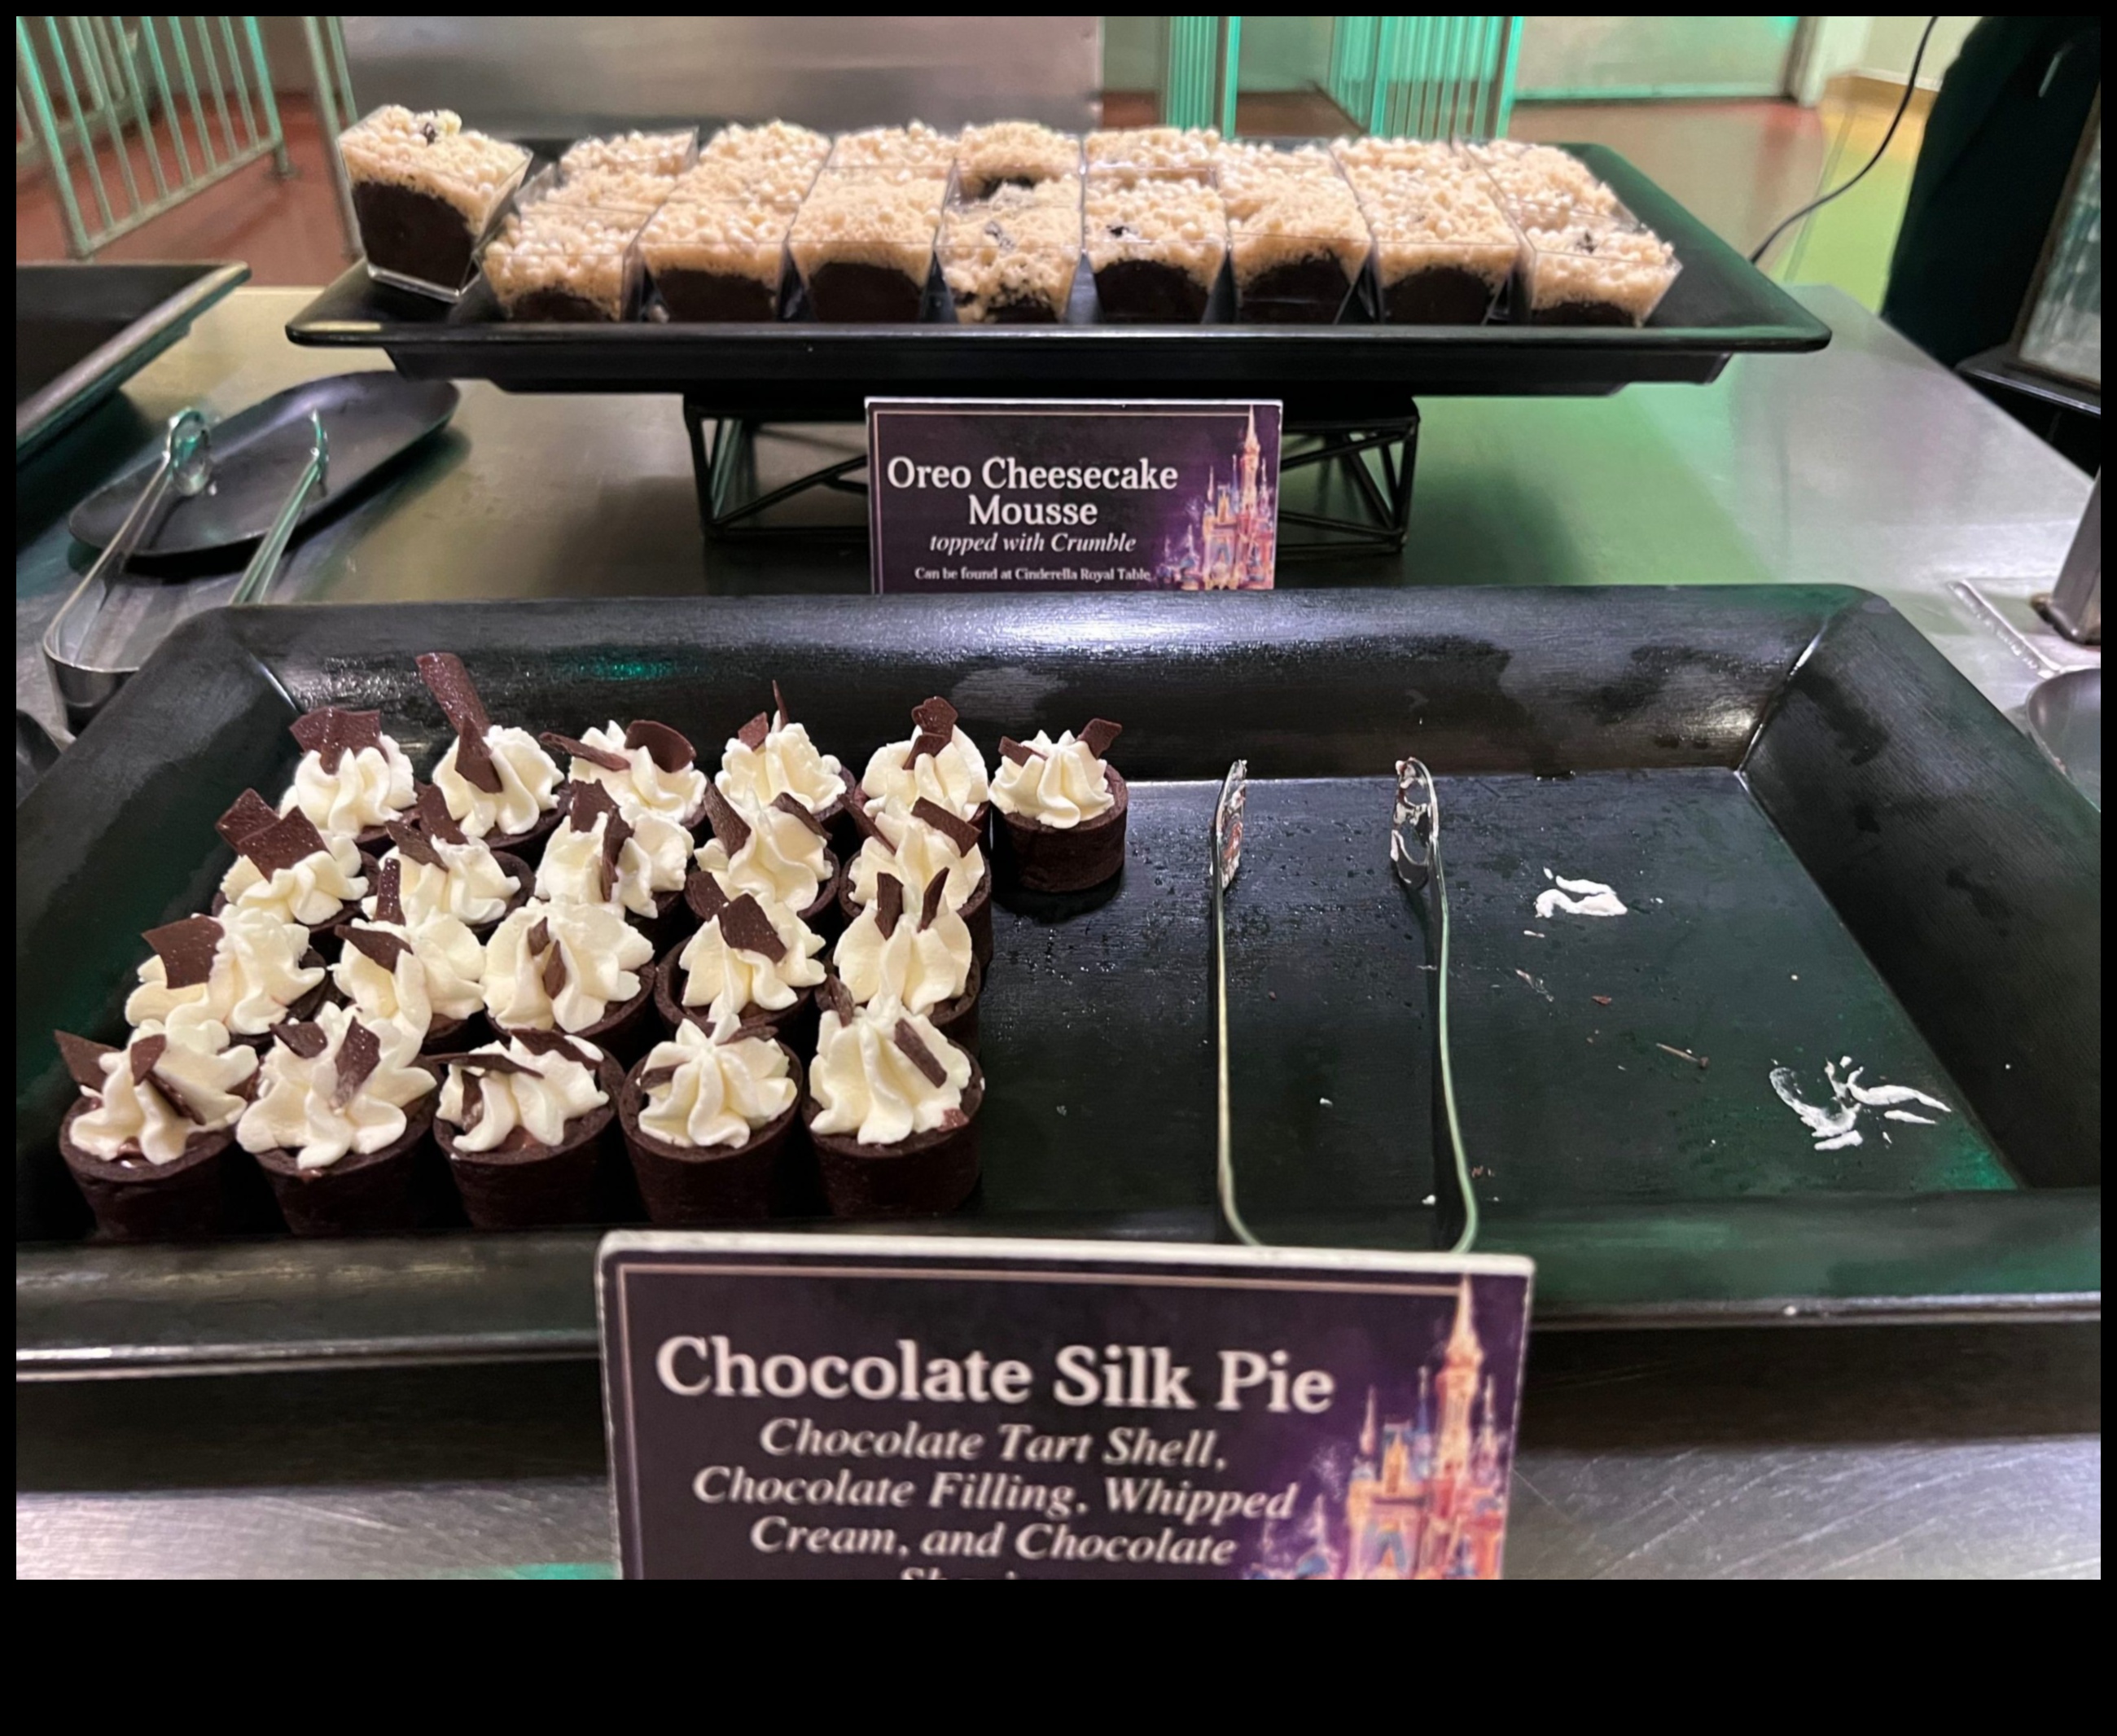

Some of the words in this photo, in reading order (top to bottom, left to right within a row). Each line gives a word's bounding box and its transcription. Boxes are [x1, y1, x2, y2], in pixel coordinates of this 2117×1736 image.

[888, 456, 971, 489] Oreo
[982, 456, 1179, 490] Cheesecake
[968, 493, 1098, 525] Mousse
[928, 533, 998, 556] topped
[1002, 533, 1045, 551] with
[1050, 533, 1137, 552] Crumble
[914, 568, 940, 579] Can
[942, 568, 958, 579] be
[961, 567, 998, 580] found
[1000, 568, 1012, 580] at
[1015, 568, 1078, 581] Cinderella
[1080, 568, 1115, 583] Royal
[656, 1335, 1032, 1403] Chocolate
[1054, 1344, 1195, 1409] Silk
[1217, 1350, 1335, 1414] Pie
[760, 1418, 983, 1459] Chocolate
[1001, 1424, 1091, 1462] Tart
[694, 1466, 914, 1506] Chocolate
[1107, 1477, 1299, 1526] Whipped
[921, 1522, 1006, 1557] and
[1015, 1524, 1237, 1565] Chocolate
